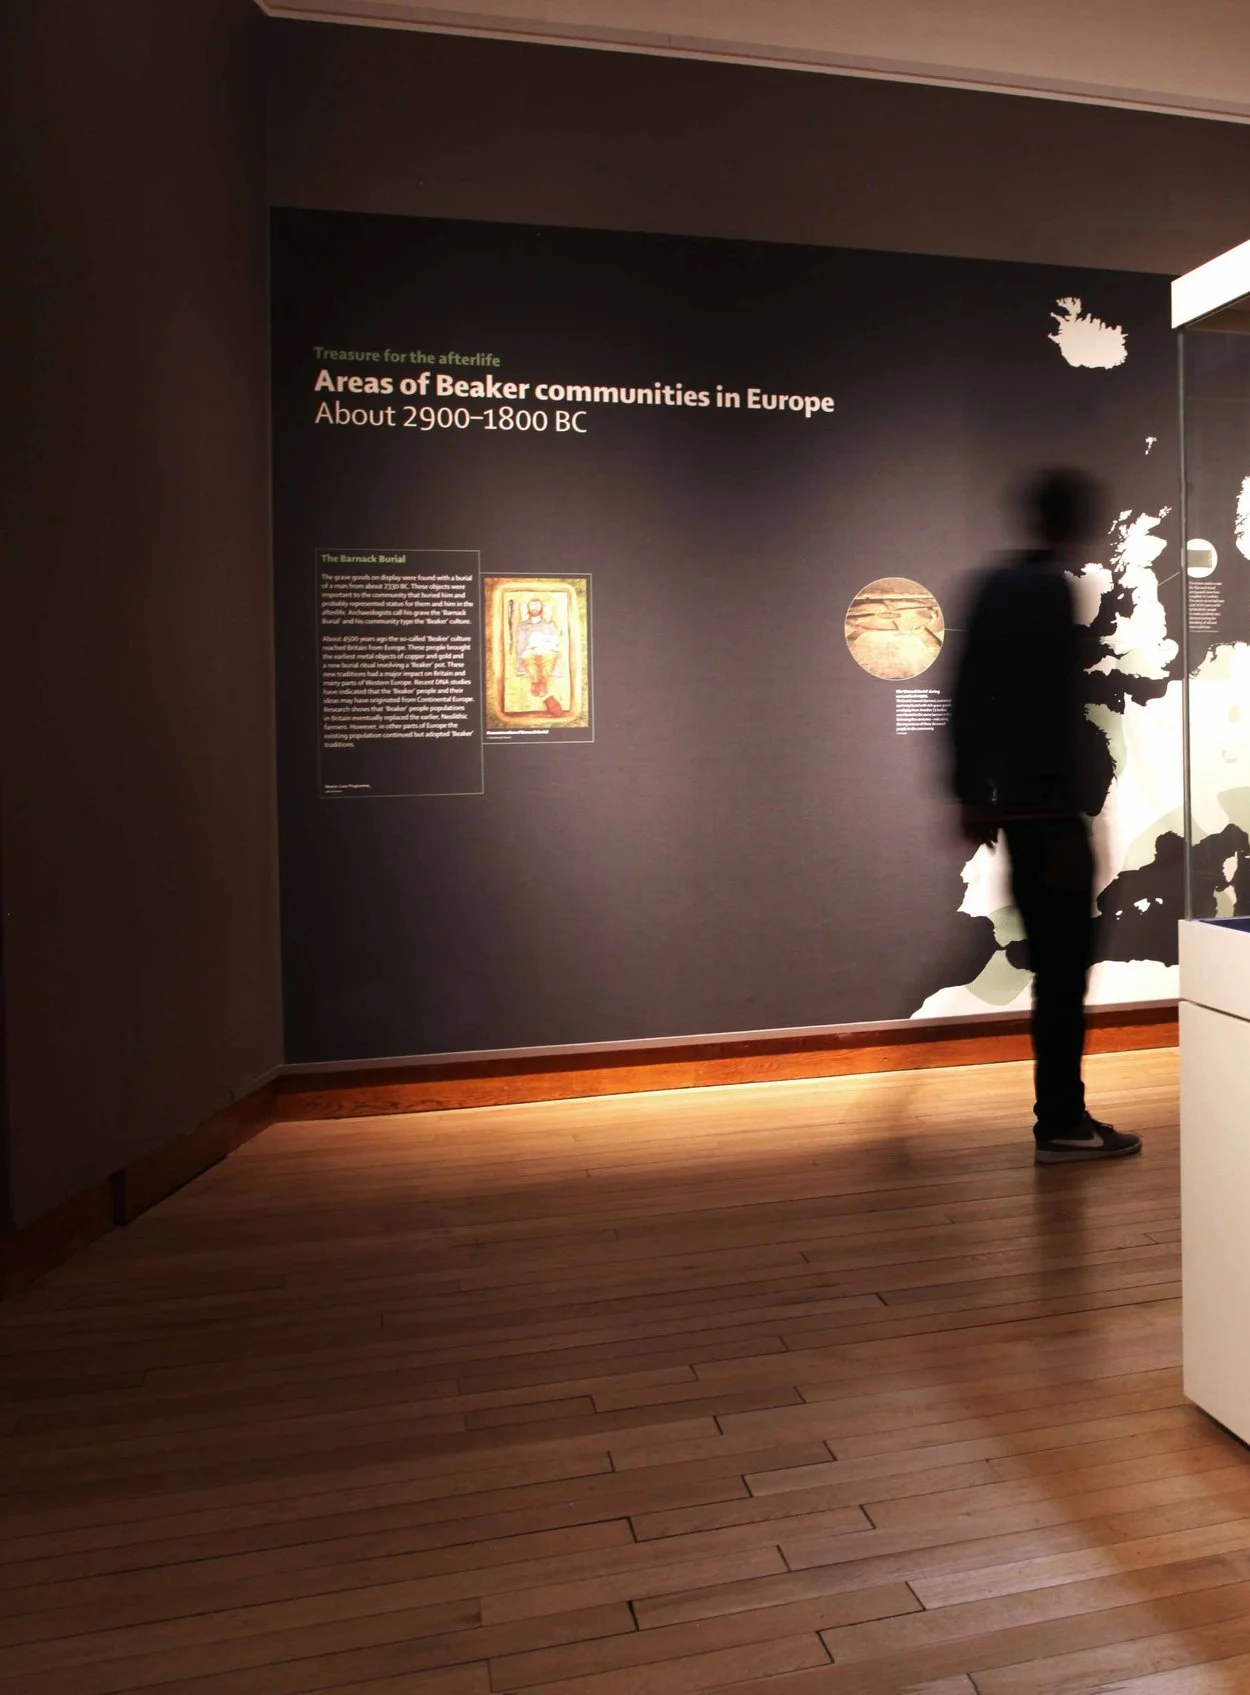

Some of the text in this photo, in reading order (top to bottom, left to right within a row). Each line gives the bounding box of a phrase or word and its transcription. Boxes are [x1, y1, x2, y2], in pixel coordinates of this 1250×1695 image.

[314, 346, 501, 367] Treasure for the afterlife
[314, 369, 835, 418] Areas of Beaker communities in Europe
[315, 400, 397, 427] About
[555, 410, 588, 433] BC
[321, 554, 406, 563] The Barnack Burial
